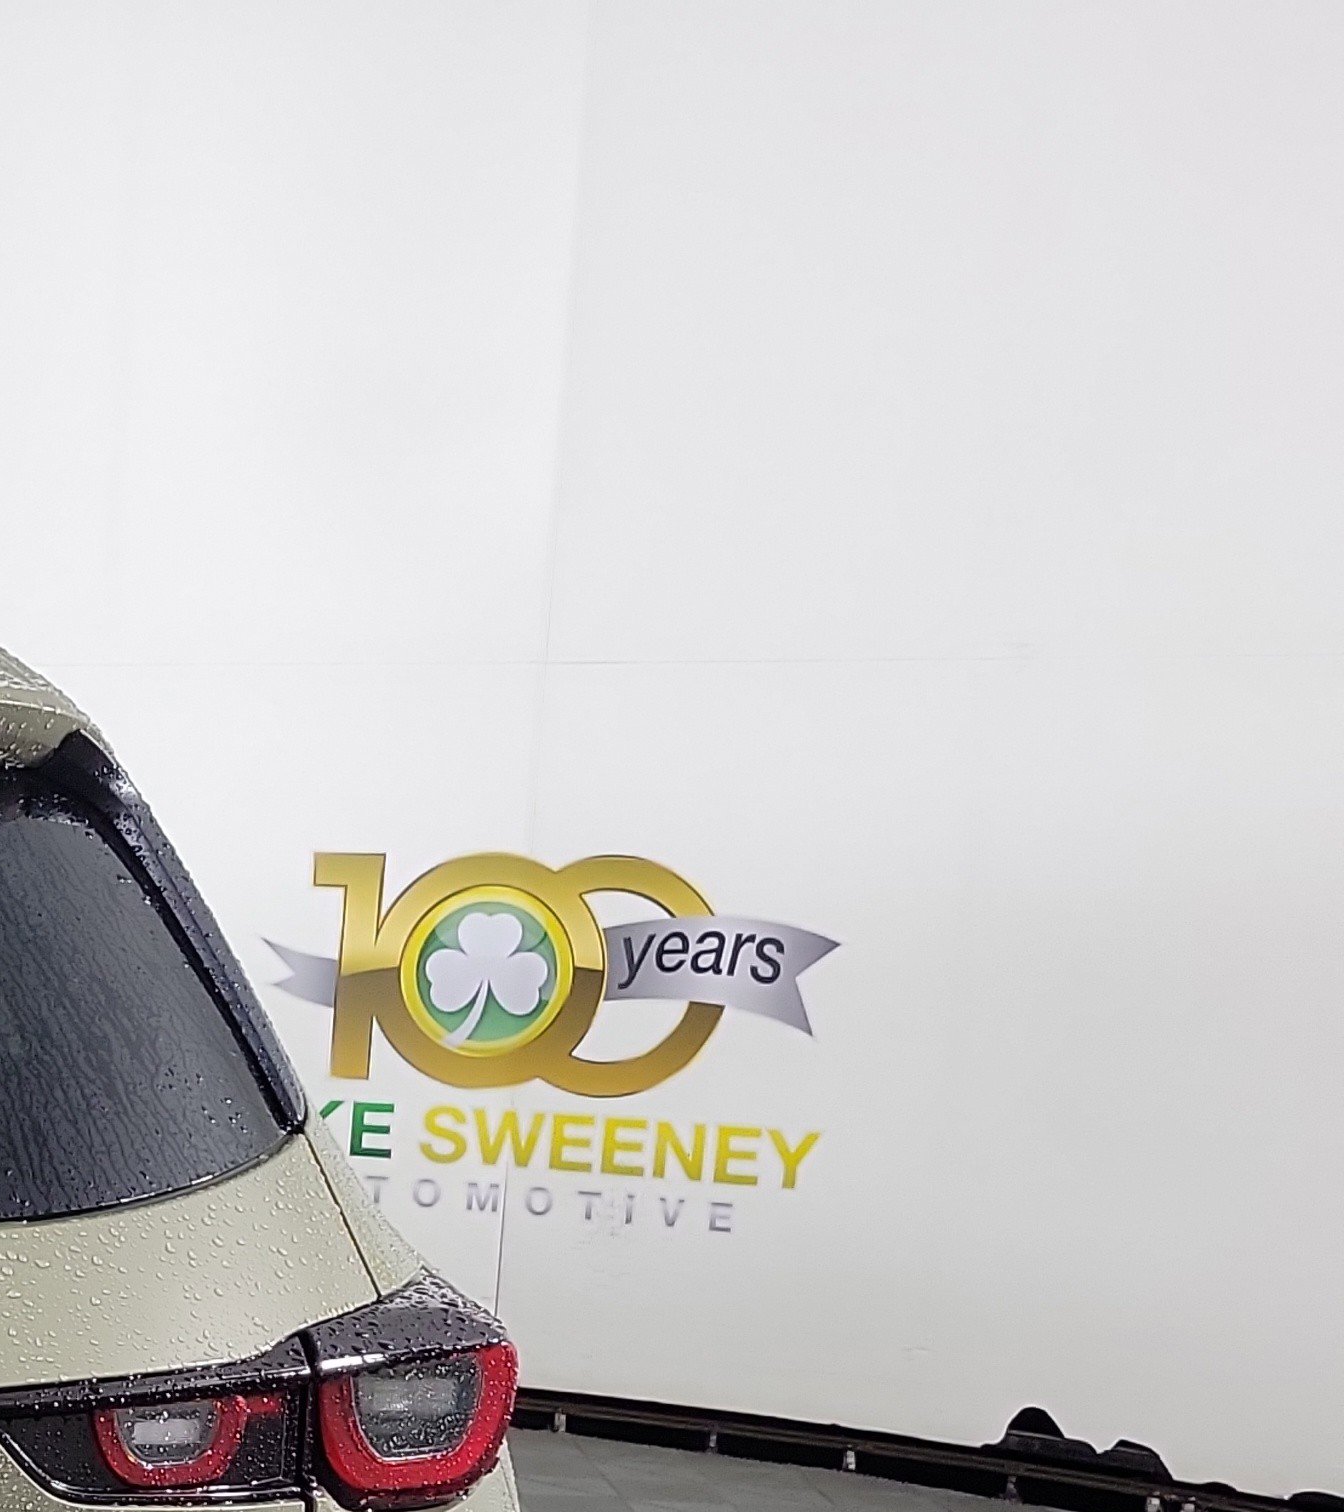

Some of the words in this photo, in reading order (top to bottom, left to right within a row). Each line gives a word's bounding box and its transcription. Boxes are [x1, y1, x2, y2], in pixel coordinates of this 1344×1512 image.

[312, 851, 725, 1098] 100
[617, 928, 785, 989] years
[319, 1100, 395, 1159] E
[418, 1104, 820, 1190] SWEENEY
